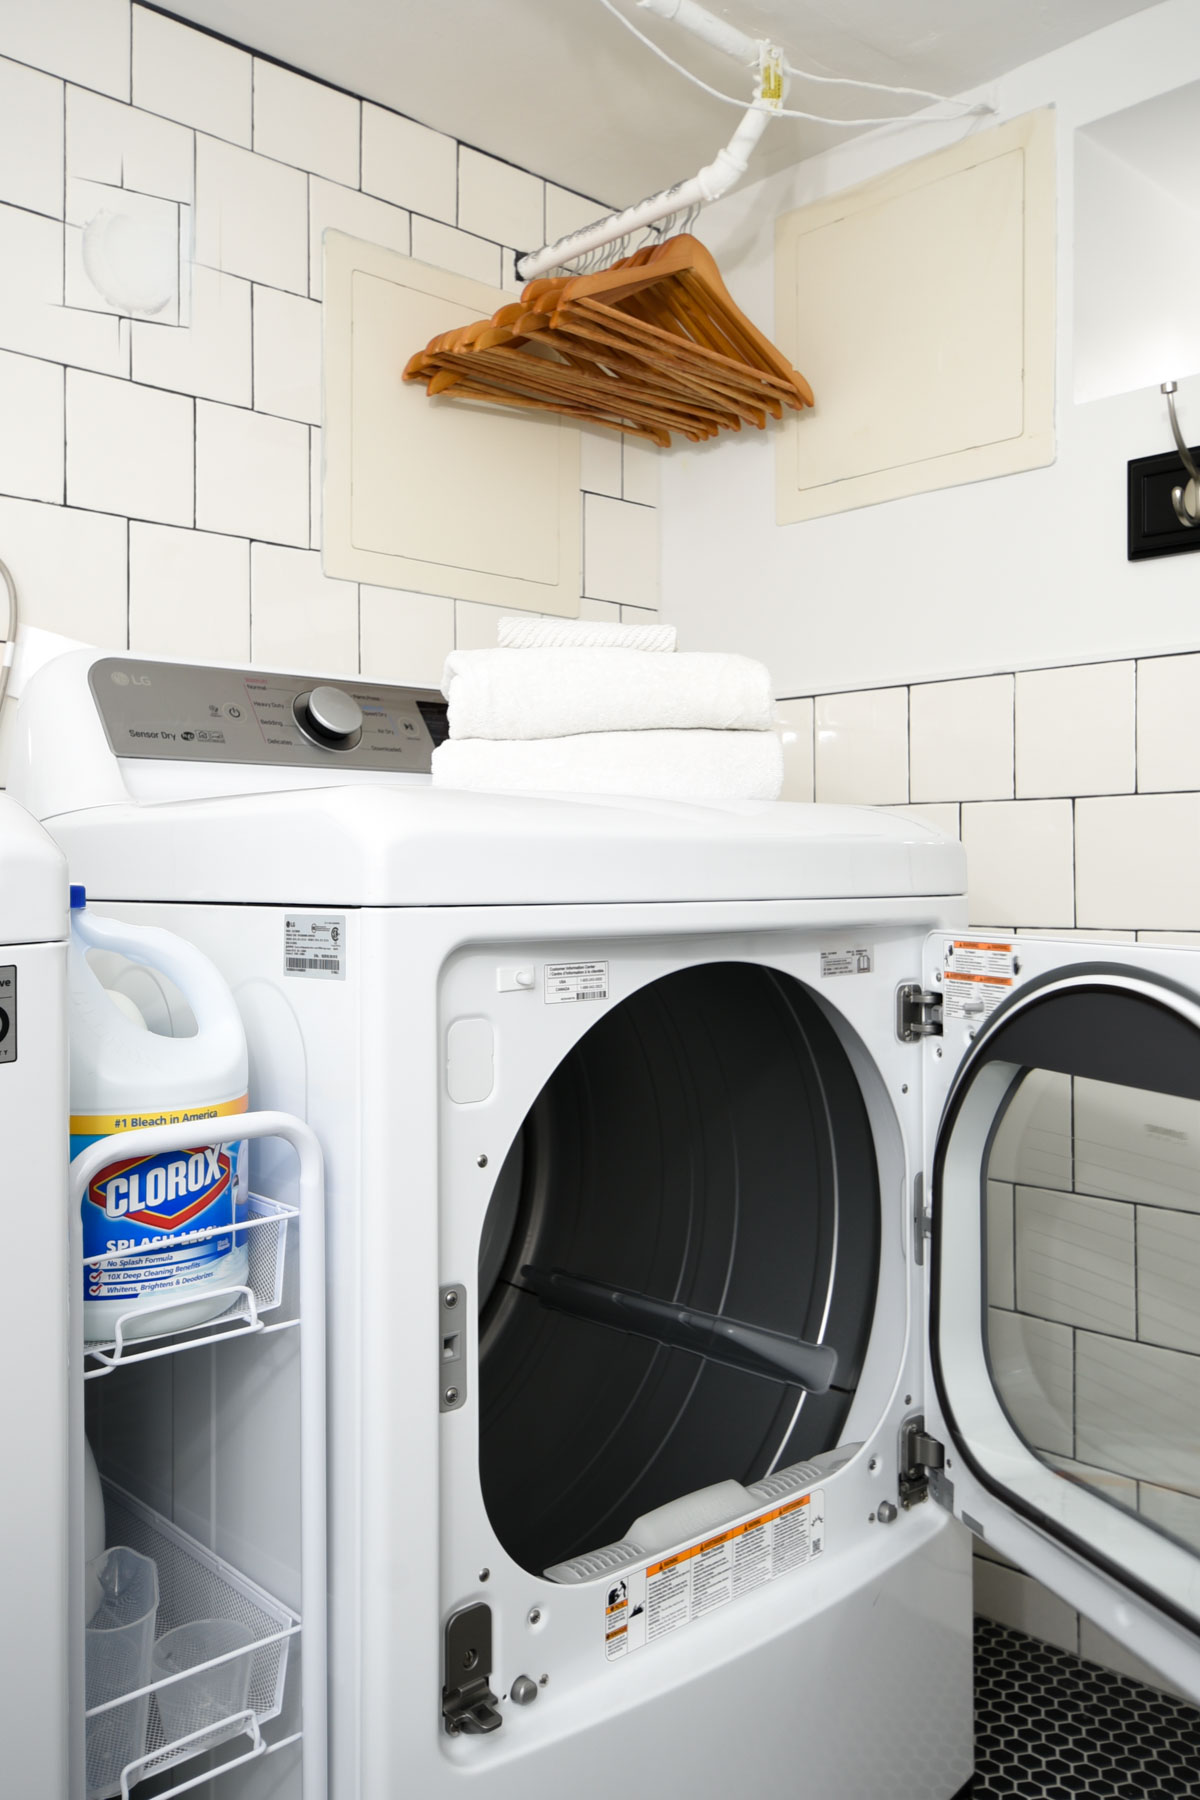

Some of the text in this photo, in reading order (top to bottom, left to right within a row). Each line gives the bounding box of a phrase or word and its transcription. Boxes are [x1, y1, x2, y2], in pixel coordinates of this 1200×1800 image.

[130, 674, 152, 686] LG
[129, 729, 159, 739] Sensor
[161, 731, 176, 741] Dry
[115, 1110, 218, 1128] #1 Bleach in America
[106, 1143, 222, 1218] CLOROX
[120, 1258, 143, 1268] Splash
[145, 1254, 173, 1264] Formula
[123, 1272, 141, 1280] Deep
[144, 1268, 174, 1277] Cleaning
[175, 1262, 200, 1272] Benefits
[107, 1285, 138, 1294] Whitens,
[140, 1281, 173, 1291] Brightens
[182, 1271, 214, 1284] Deodorizes
